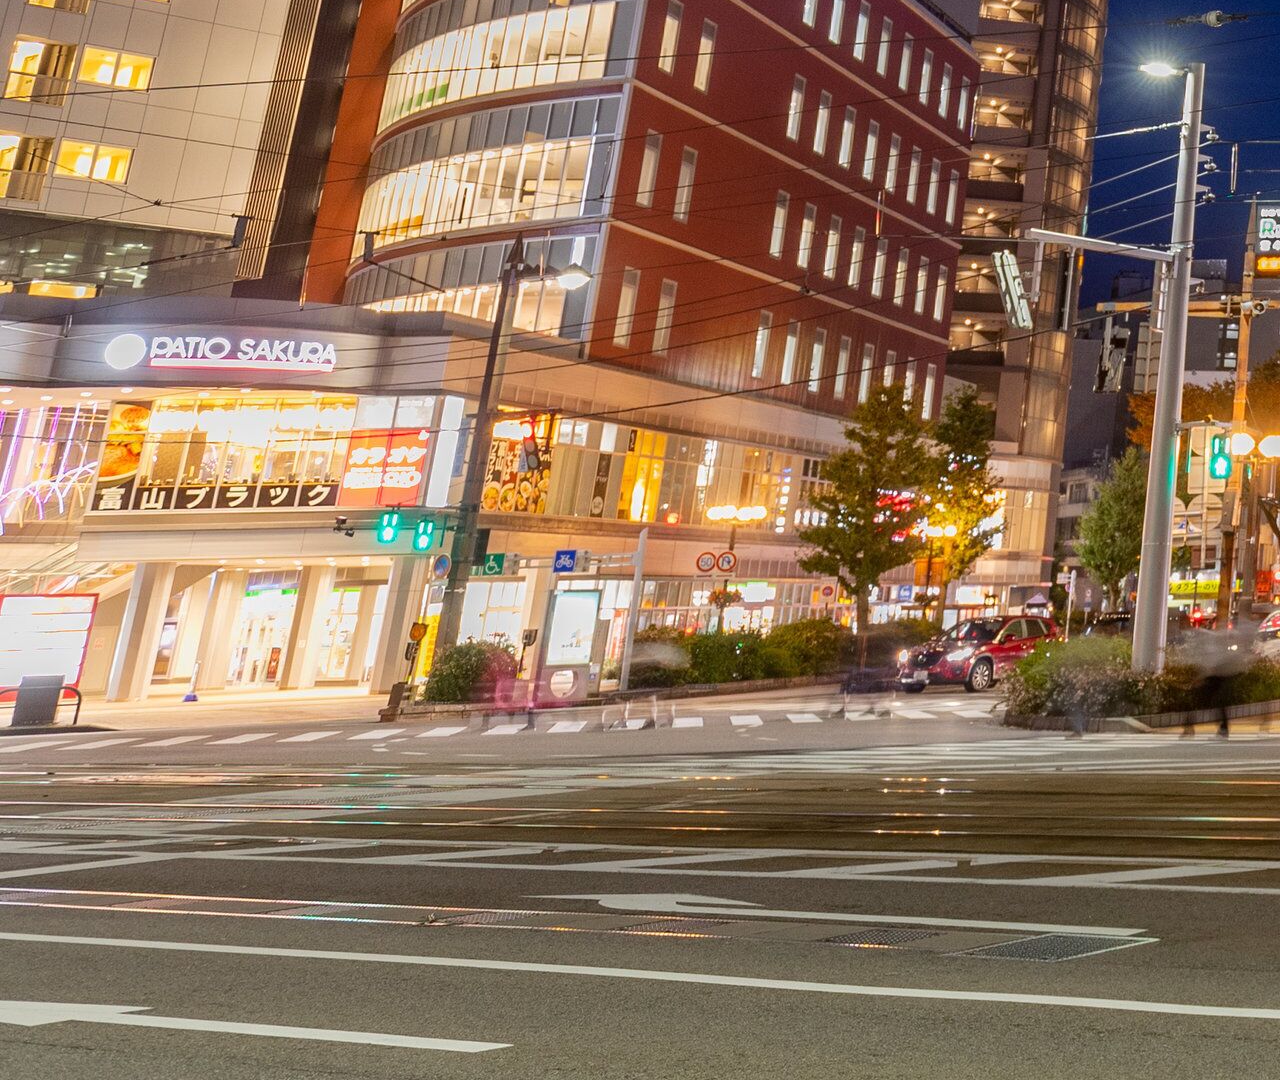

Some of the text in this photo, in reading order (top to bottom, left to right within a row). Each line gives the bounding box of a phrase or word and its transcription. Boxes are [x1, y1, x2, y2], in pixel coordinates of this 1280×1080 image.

[150, 336, 337, 365] PATIO SAKURA
[98, 486, 332, 510] 富山ブラック
[701, 557, 713, 568] 50
